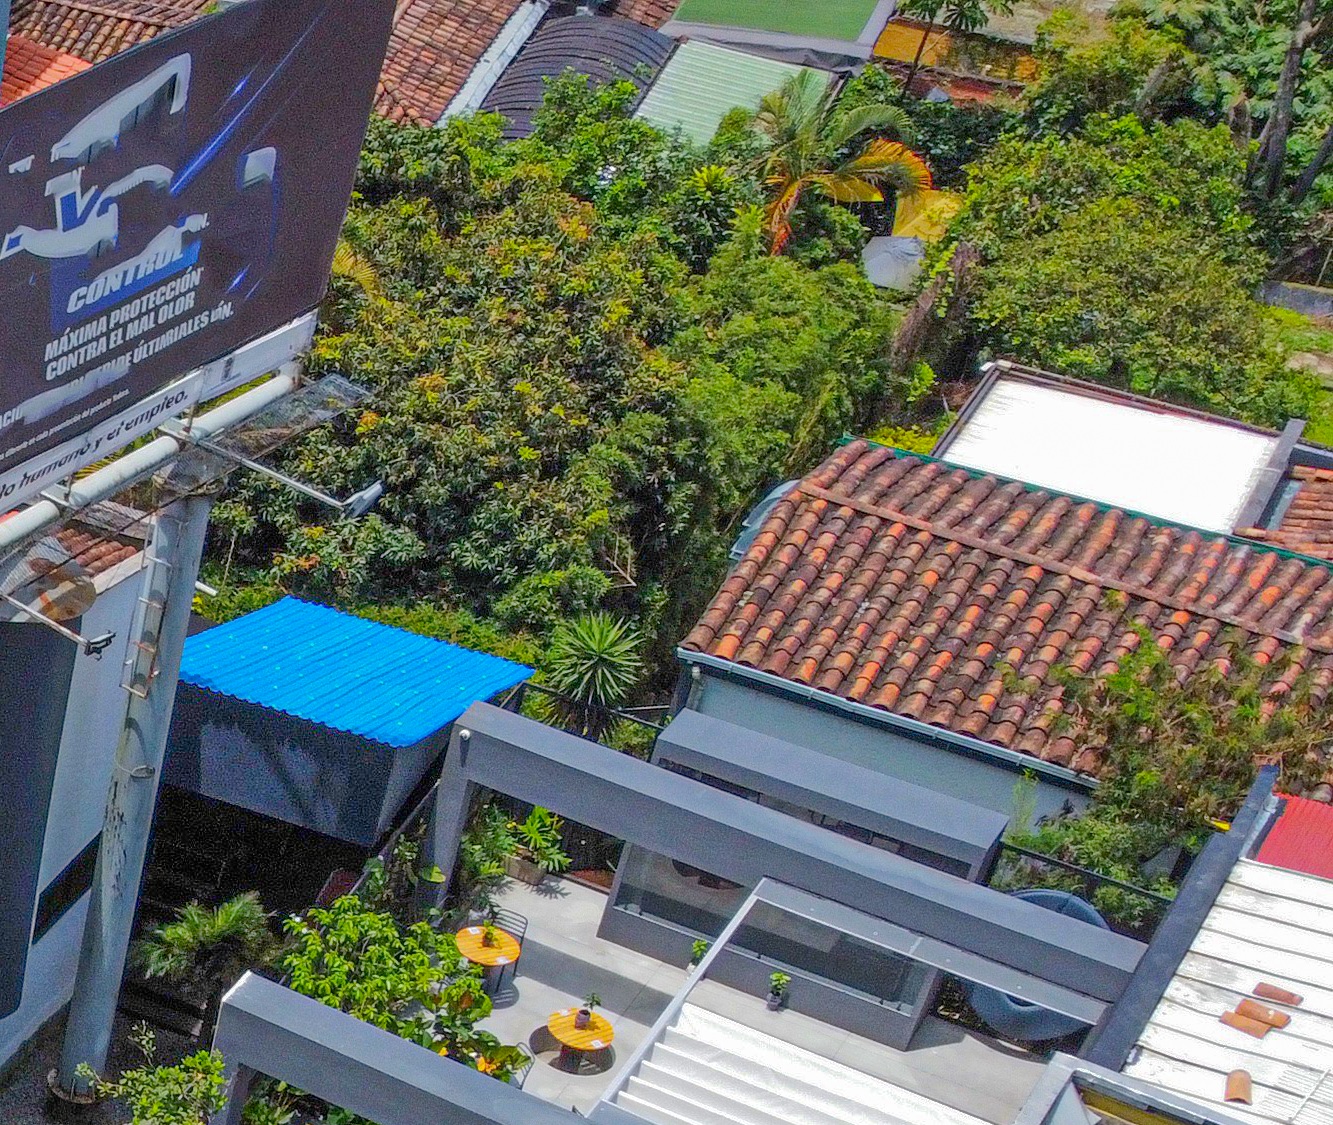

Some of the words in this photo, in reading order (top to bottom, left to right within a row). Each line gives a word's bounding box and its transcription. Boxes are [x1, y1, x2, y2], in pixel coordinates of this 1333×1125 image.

[44, 316, 108, 361] MÁXIMA
[45, 338, 108, 381] CONTRA
[109, 331, 126, 351] EL
[126, 315, 156, 342] MAL
[157, 290, 195, 322] OLOR
[18, 443, 91, 489] humano
